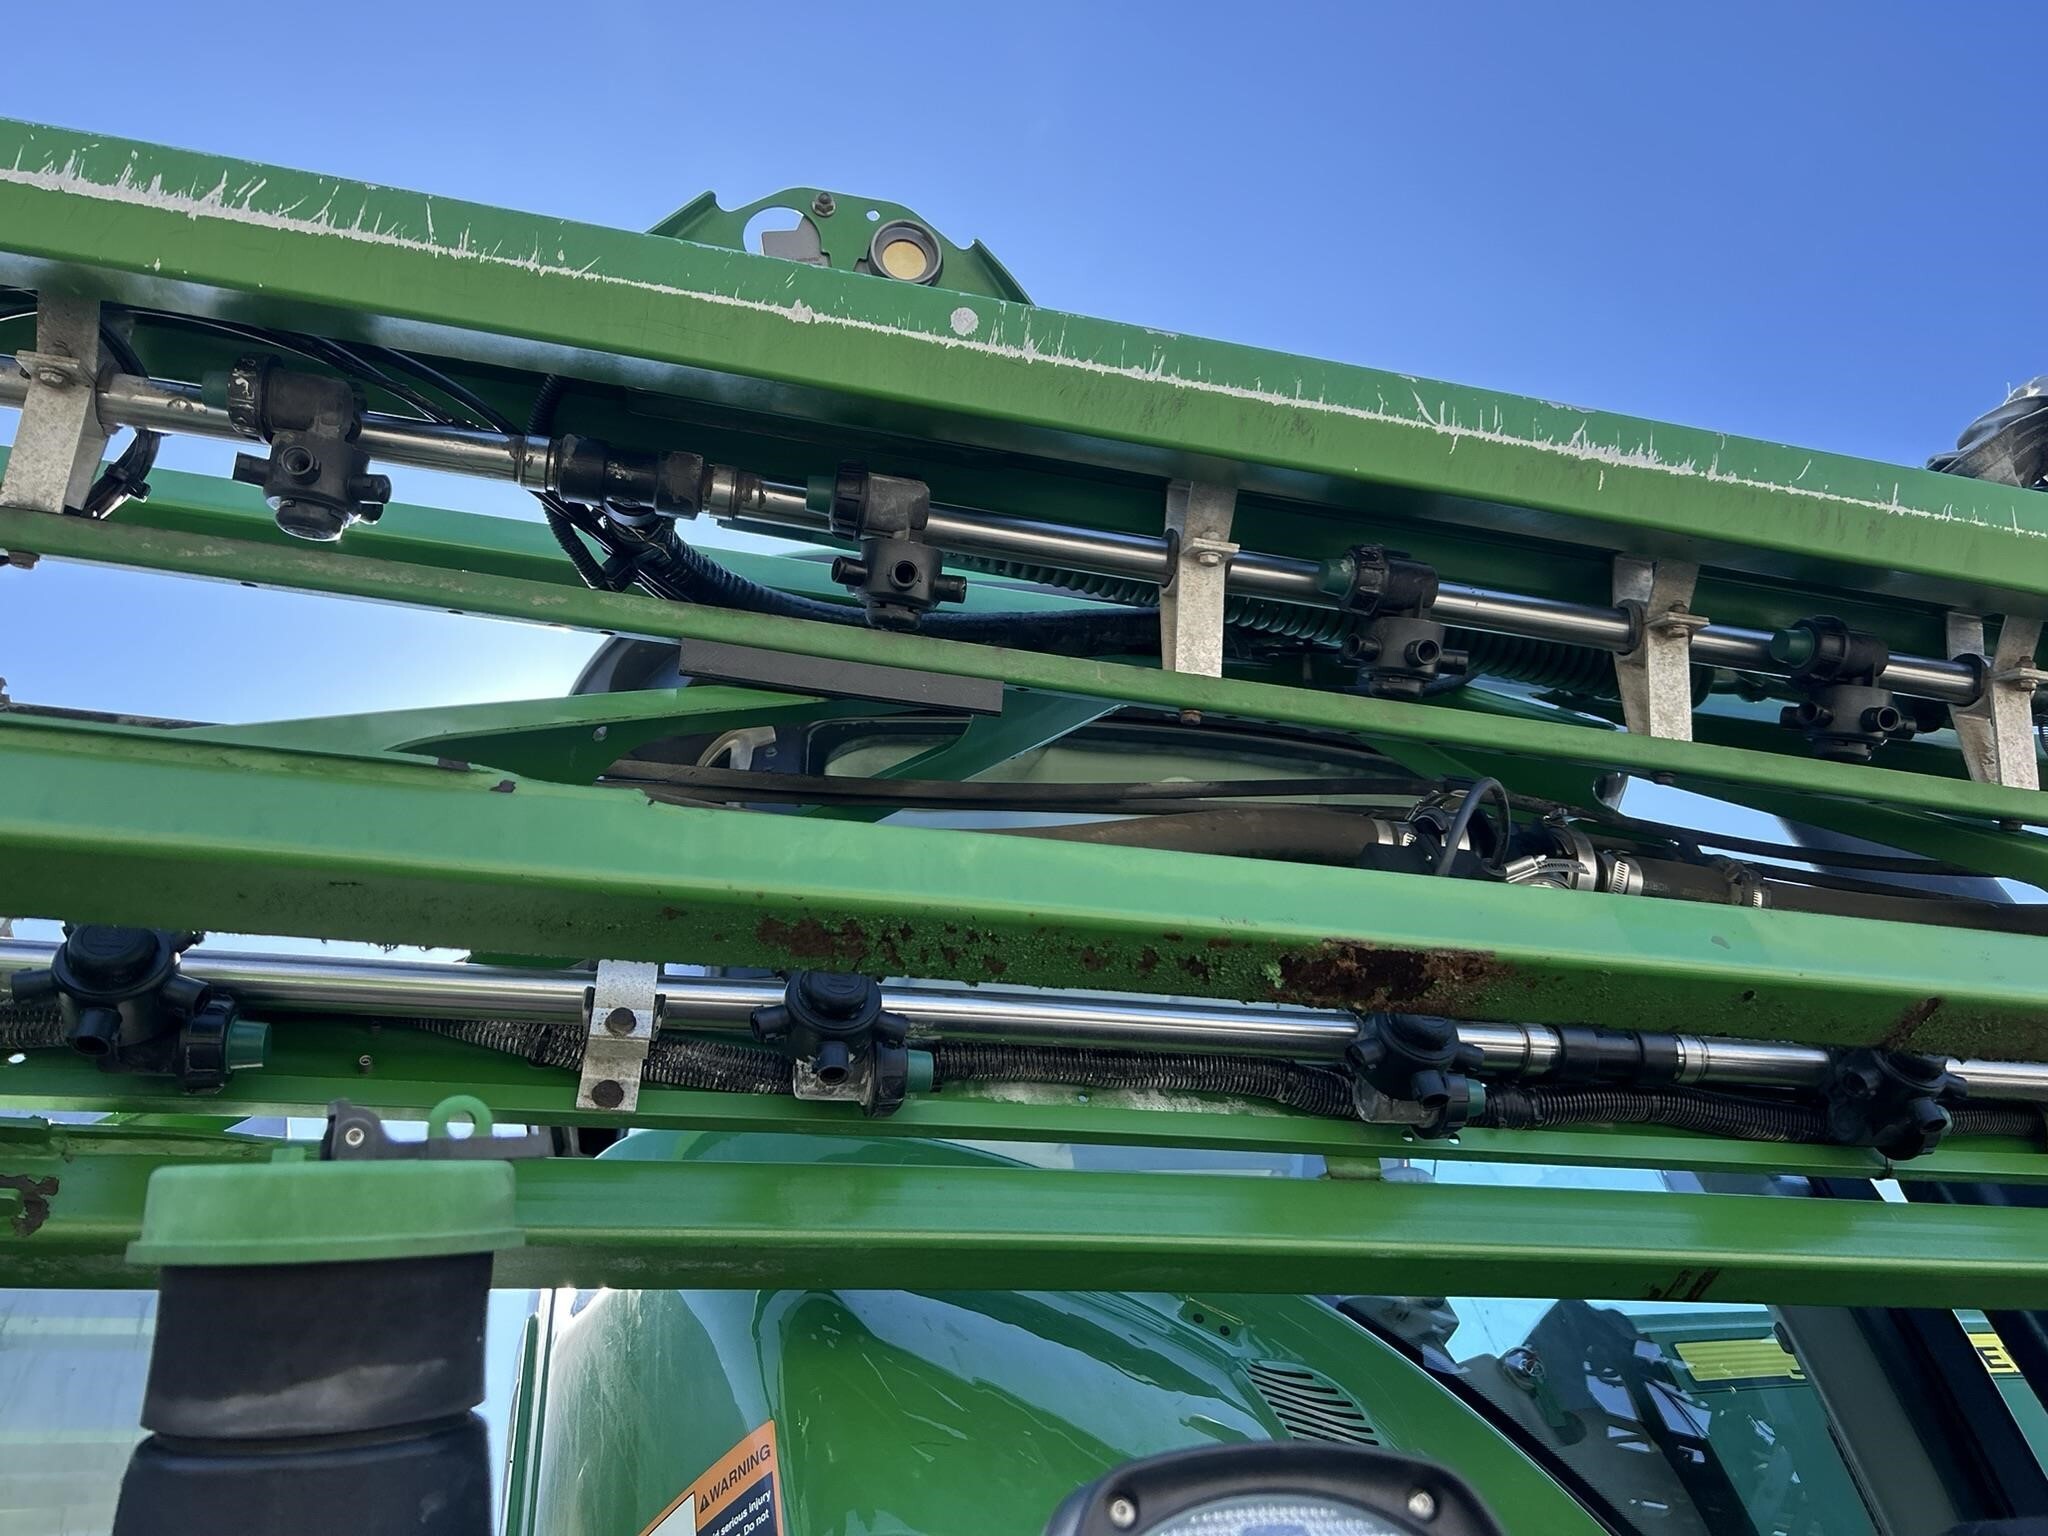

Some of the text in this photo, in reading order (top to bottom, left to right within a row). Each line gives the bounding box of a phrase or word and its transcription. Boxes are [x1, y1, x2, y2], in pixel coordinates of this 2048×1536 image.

[709, 1444, 771, 1503] WARNING
[720, 1490, 771, 1536] serious injury
[743, 1508, 770, 1536] Do not
